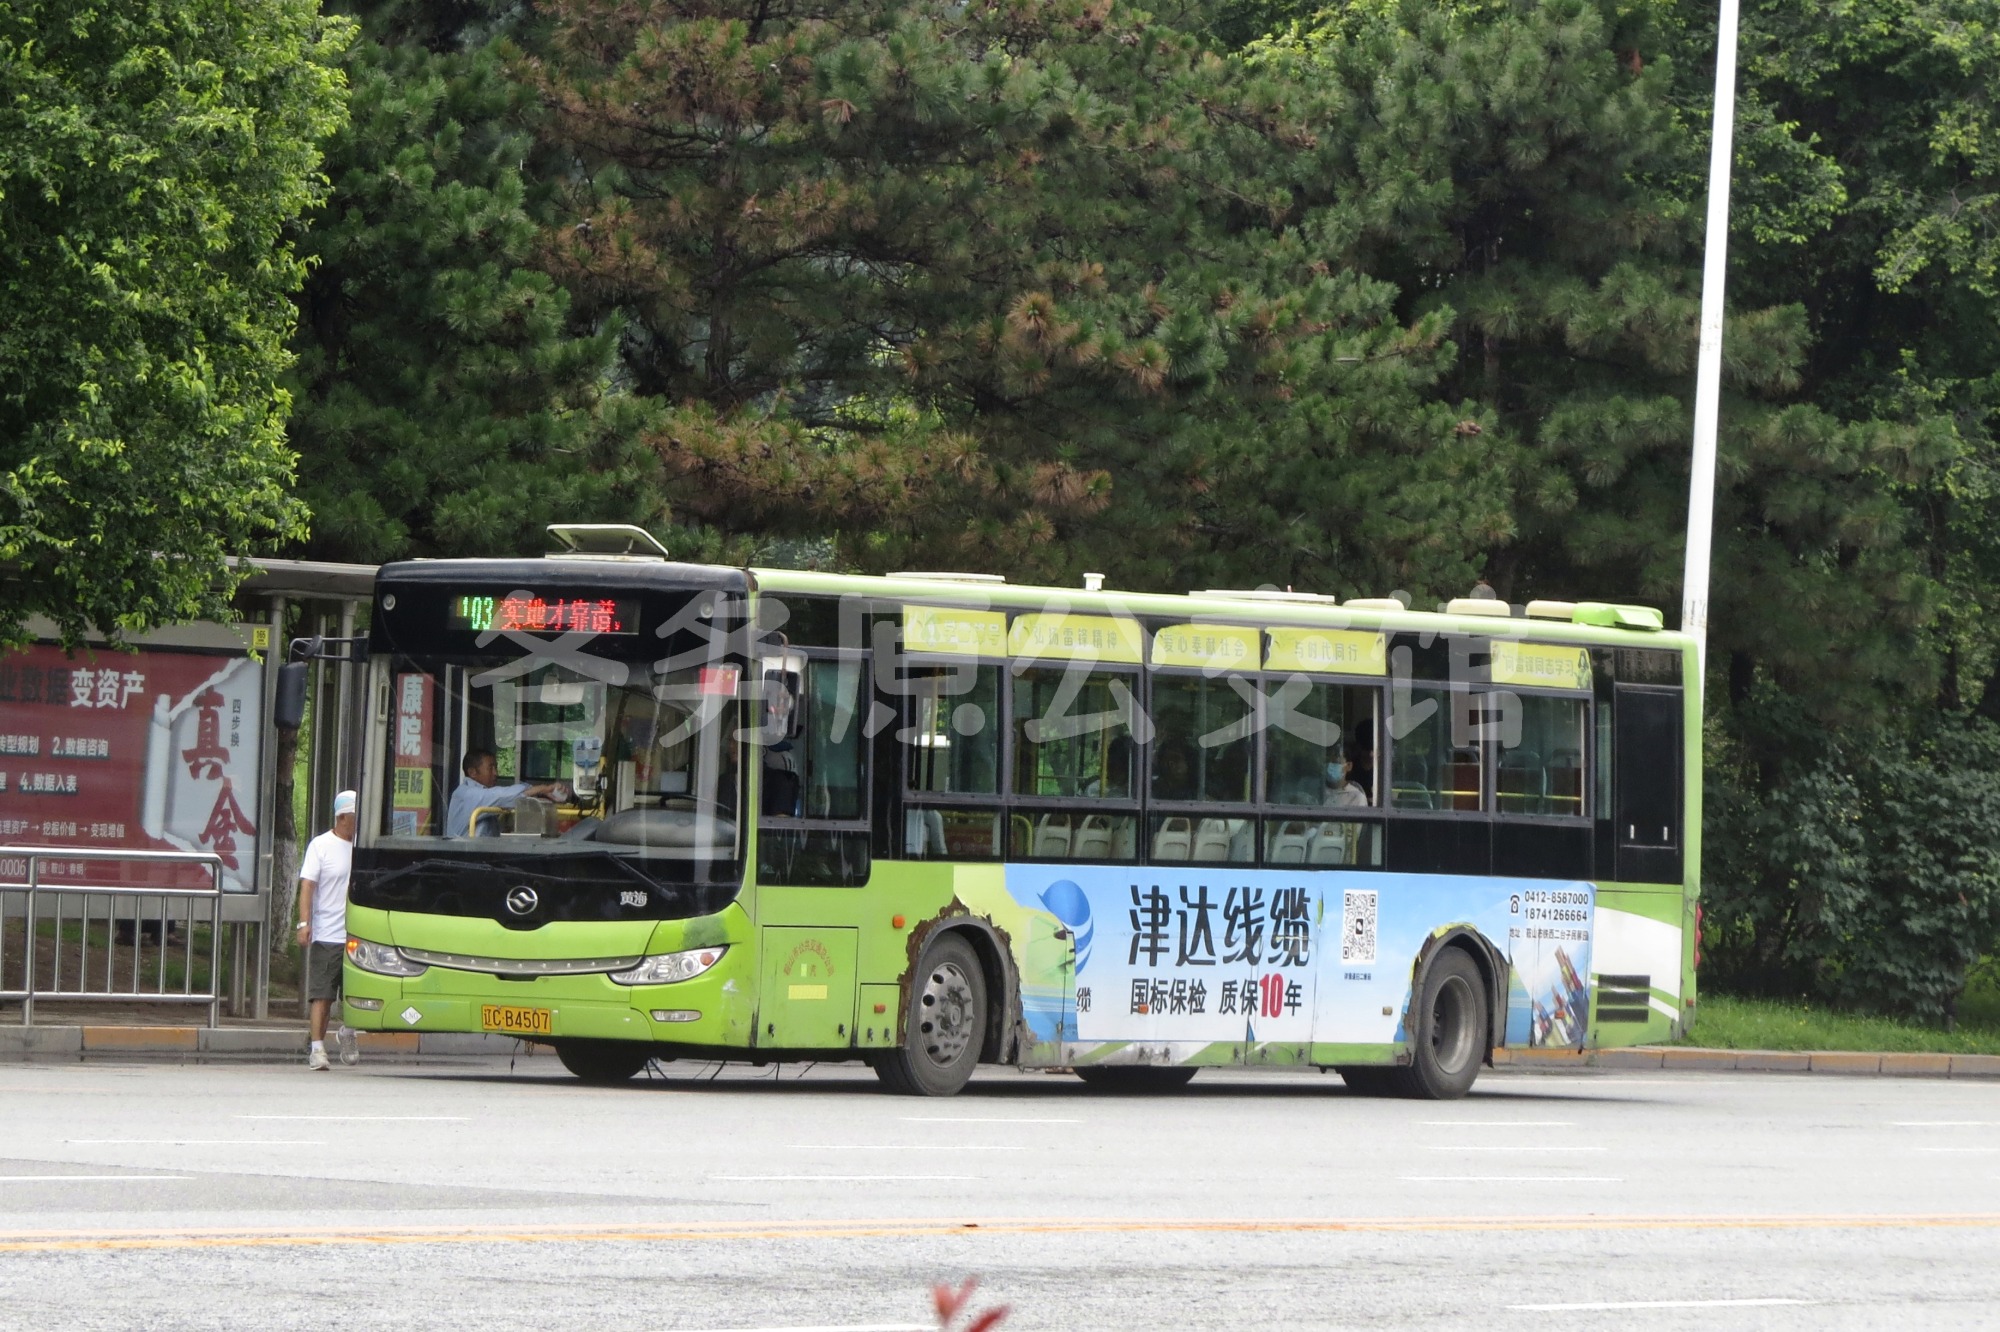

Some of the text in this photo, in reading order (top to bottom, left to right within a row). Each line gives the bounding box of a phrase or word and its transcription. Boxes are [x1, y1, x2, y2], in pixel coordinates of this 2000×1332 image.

[462, 596, 494, 630] 103
[1034, 622, 1118, 649] 弘扬雷锋精神
[1163, 634, 1245, 657] 爱心奉献社会
[1294, 639, 1359, 662] 与时代同行
[1503, 654, 1574, 677] 向雷锋同志学习
[20, 772, 77, 792] 4.数据入表
[182, 684, 257, 871] 真金
[394, 770, 424, 794] 胃肠
[42, 821, 77, 836] 挖掘价值
[91, 823, 126, 838] 变现增值
[620, 890, 648, 907] 黄海
[1525, 890, 1589, 905] 0412-8587000
[1128, 884, 1311, 968] 津达线缆
[1525, 907, 1588, 922] 18741266664
[1130, 973, 1303, 1018] 国标保检 质保10年
